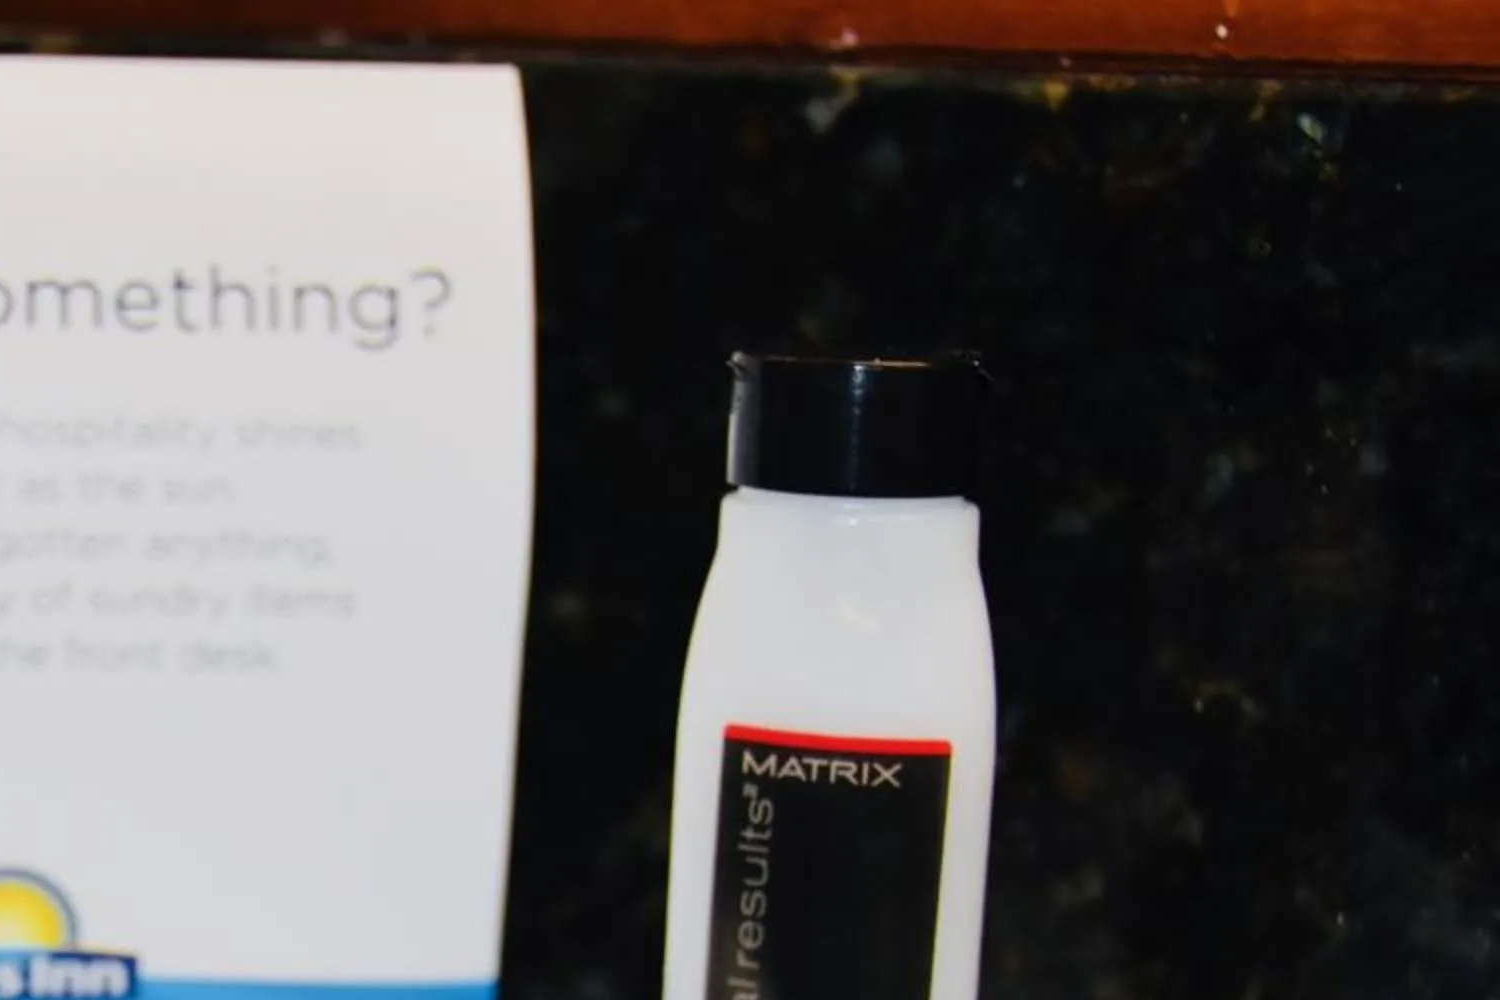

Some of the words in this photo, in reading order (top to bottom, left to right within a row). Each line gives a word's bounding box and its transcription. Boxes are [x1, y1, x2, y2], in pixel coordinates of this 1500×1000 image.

[233, 414, 363, 450] shines
[18, 474, 61, 504] as
[74, 470, 143, 504] the
[30, 577, 75, 614] of
[88, 578, 229, 623] sundry
[245, 582, 357, 618] items
[62, 634, 163, 672] front
[742, 750, 902, 787] MATRIX
[28, 952, 130, 1000] Inn
